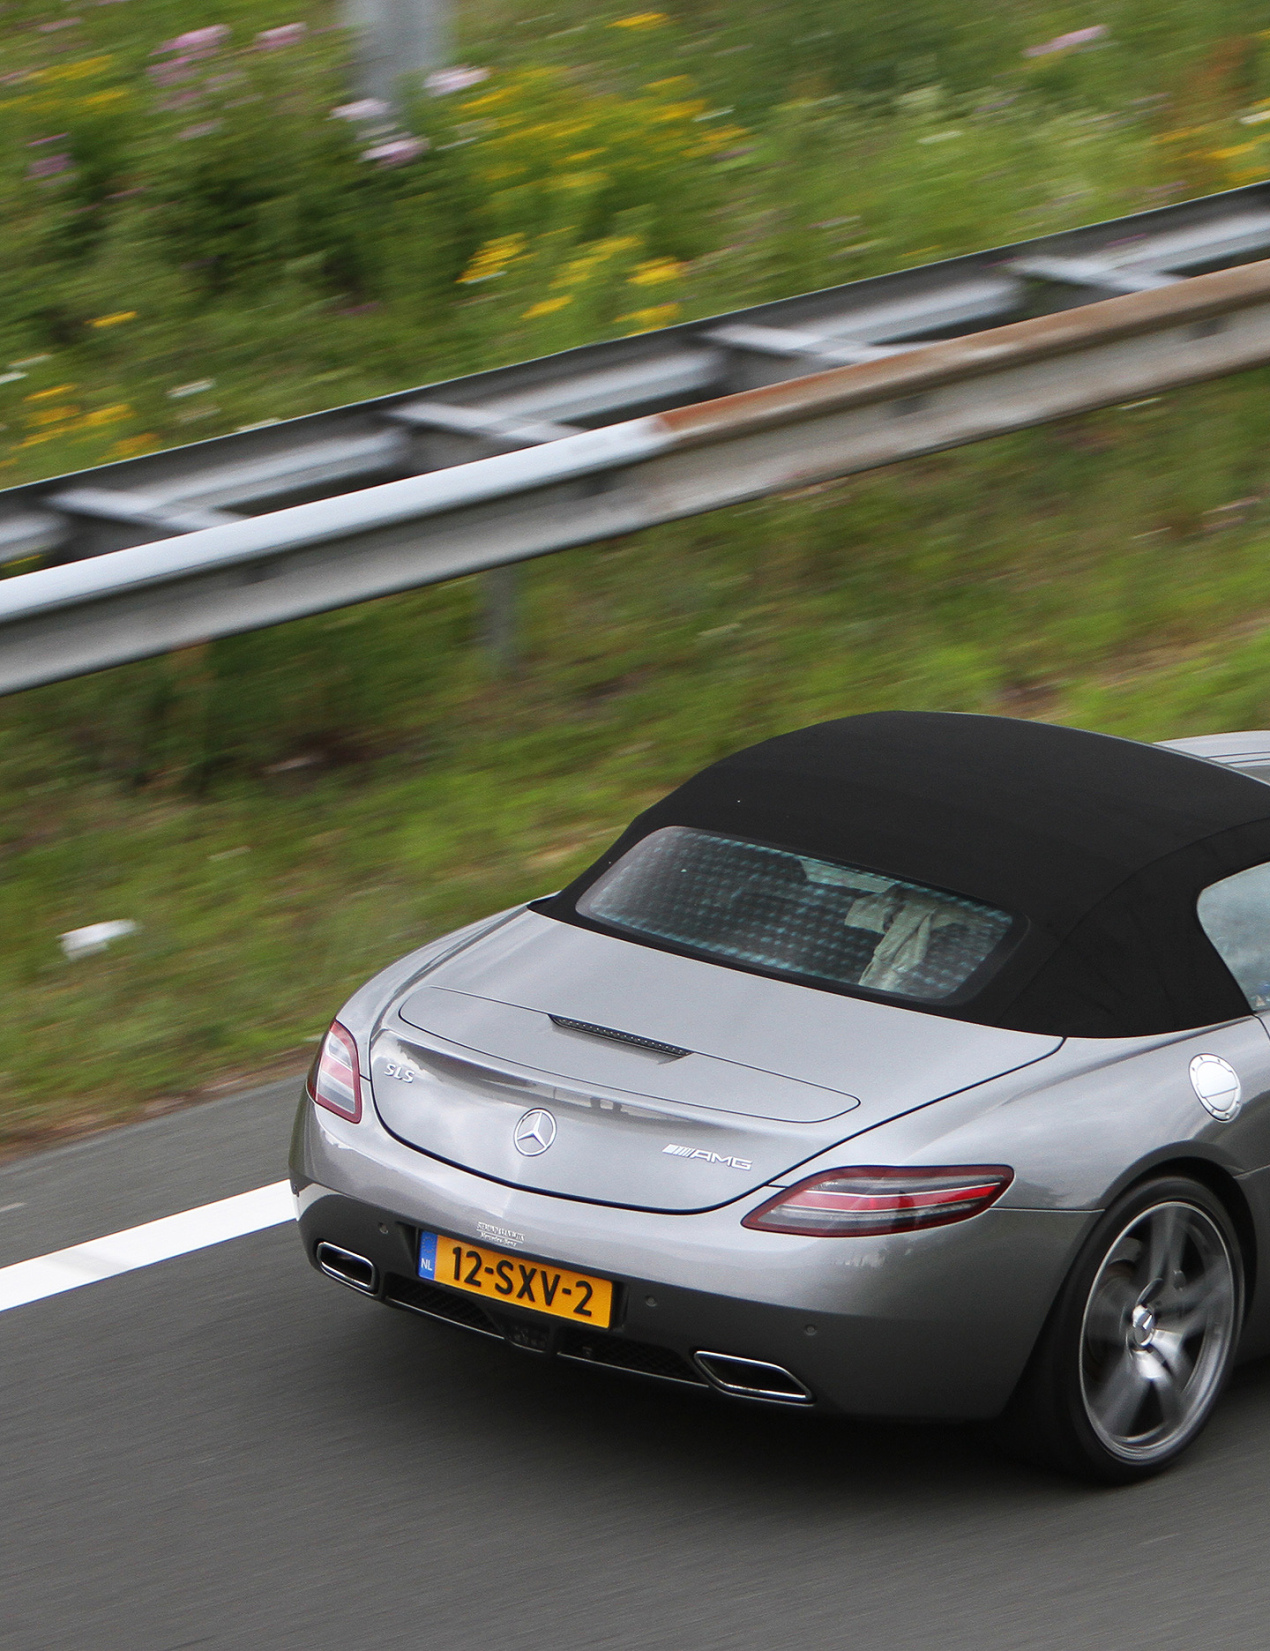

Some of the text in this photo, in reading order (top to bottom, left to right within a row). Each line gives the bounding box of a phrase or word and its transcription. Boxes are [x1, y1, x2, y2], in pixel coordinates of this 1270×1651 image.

[383, 1063, 415, 1083] SLS
[690, 1149, 753, 1171] AMG
[421, 1257, 433, 1272] NL
[452, 1246, 593, 1317] 12-SXV-2
